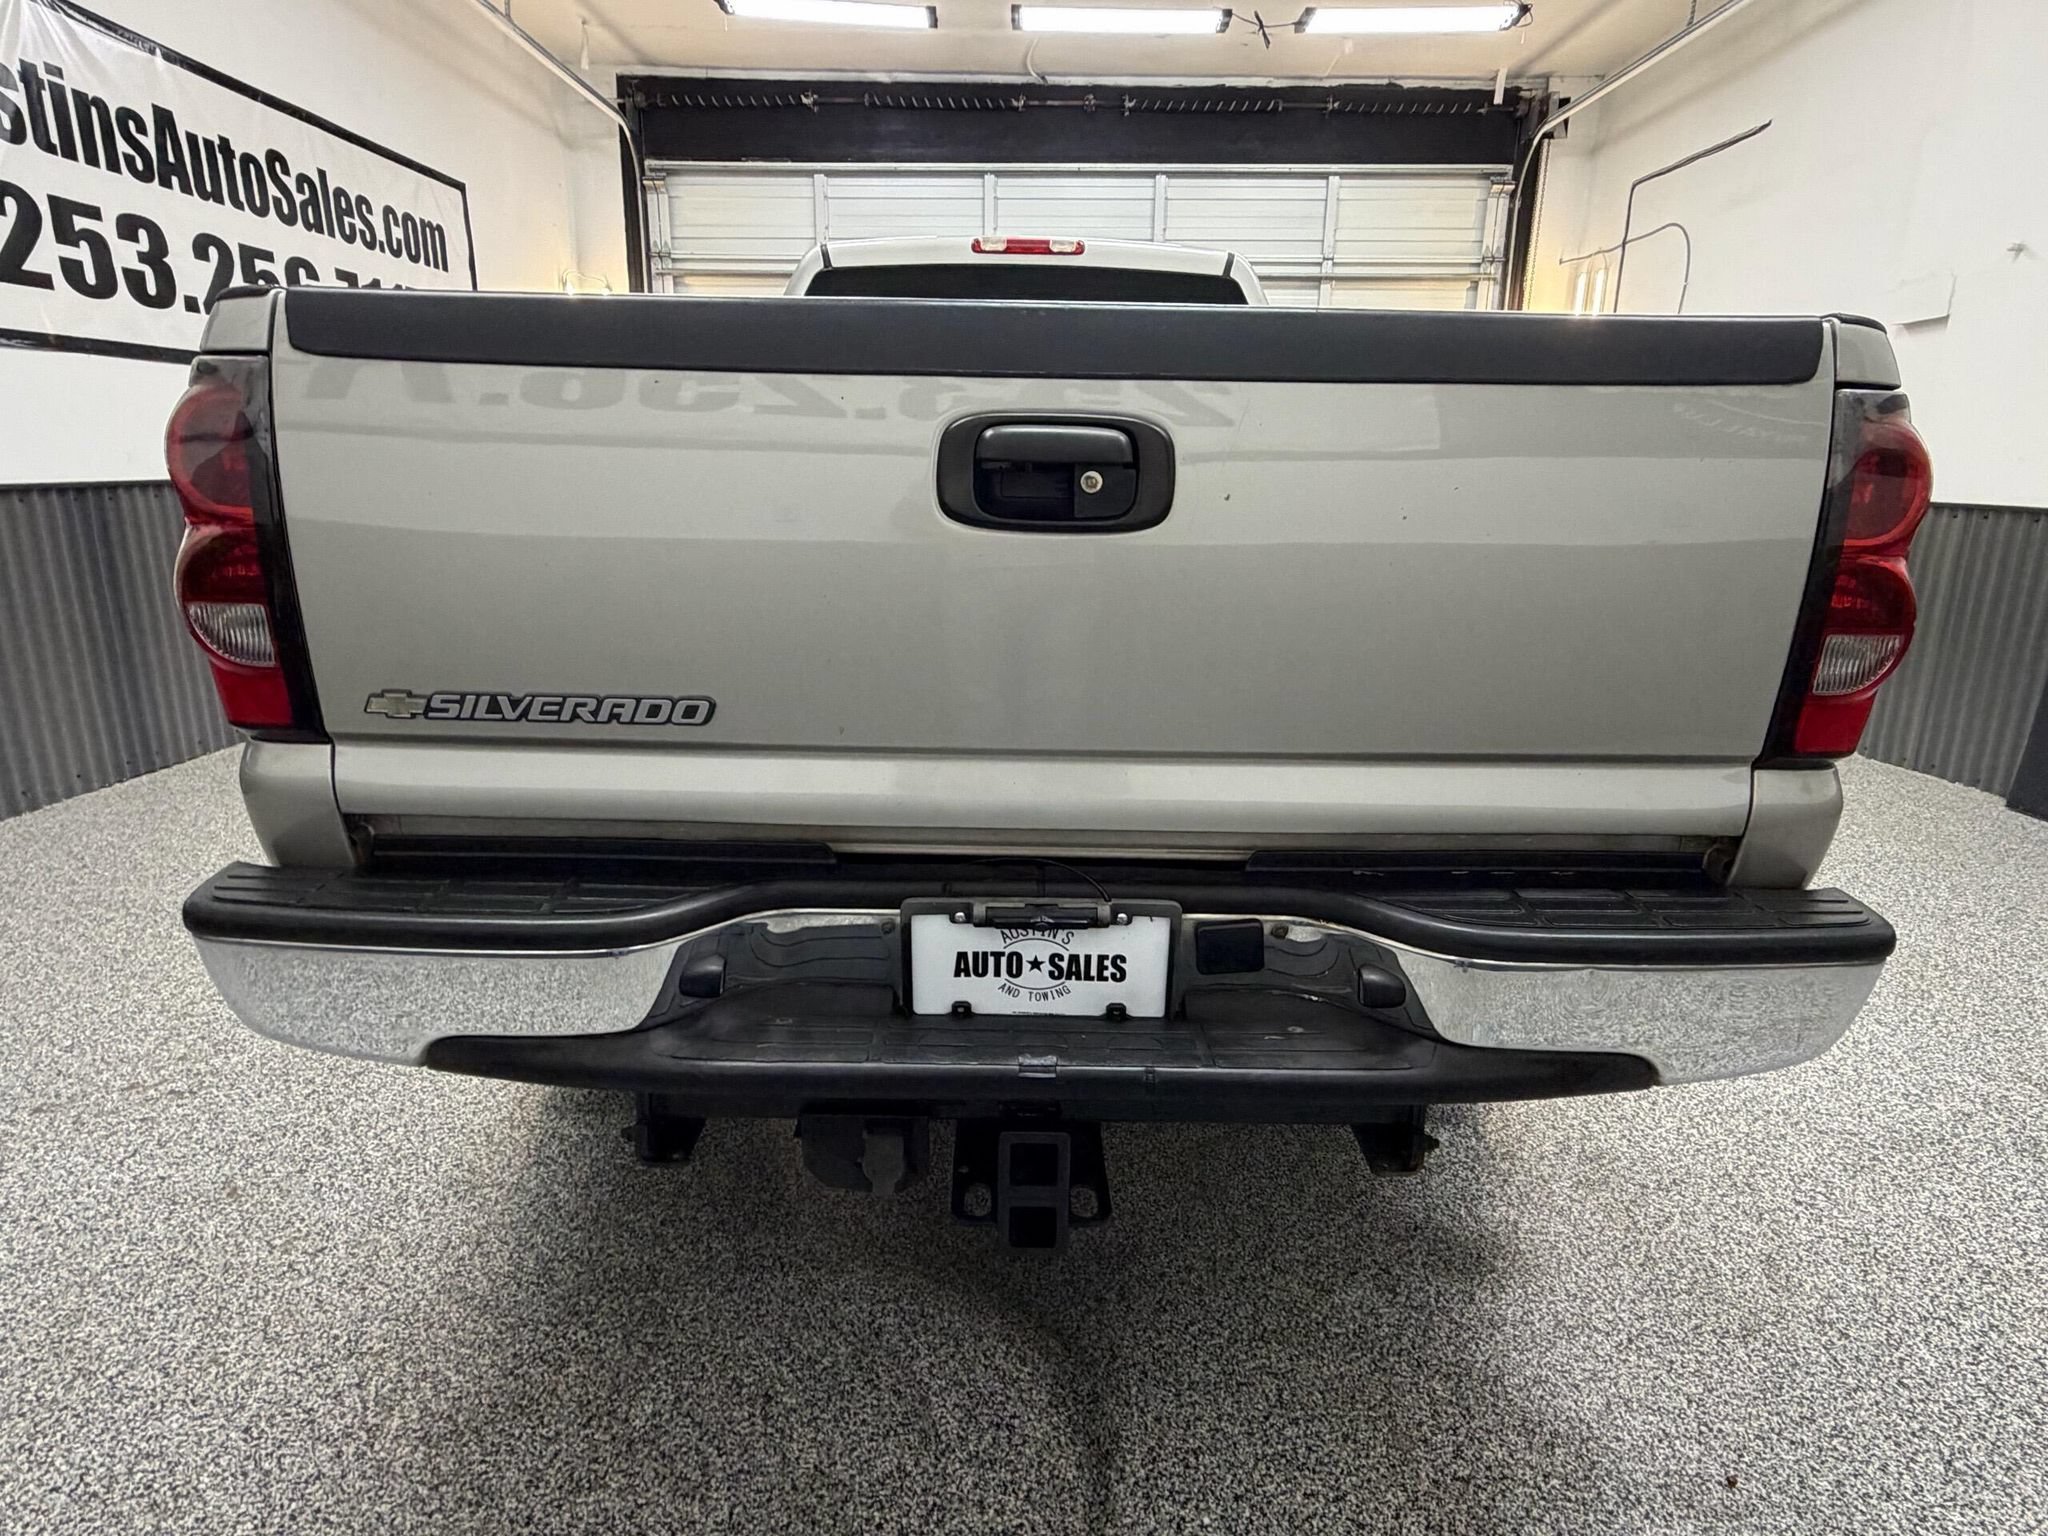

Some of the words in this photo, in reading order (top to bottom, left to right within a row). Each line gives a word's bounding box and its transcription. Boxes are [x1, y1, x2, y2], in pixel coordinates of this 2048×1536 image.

[423, 692, 713, 726] SILVERADO
[953, 951, 1023, 979] AUTO
[1048, 953, 1127, 983] SALES
[998, 983, 1020, 998] AND
[1028, 985, 1071, 1002] TOWING
